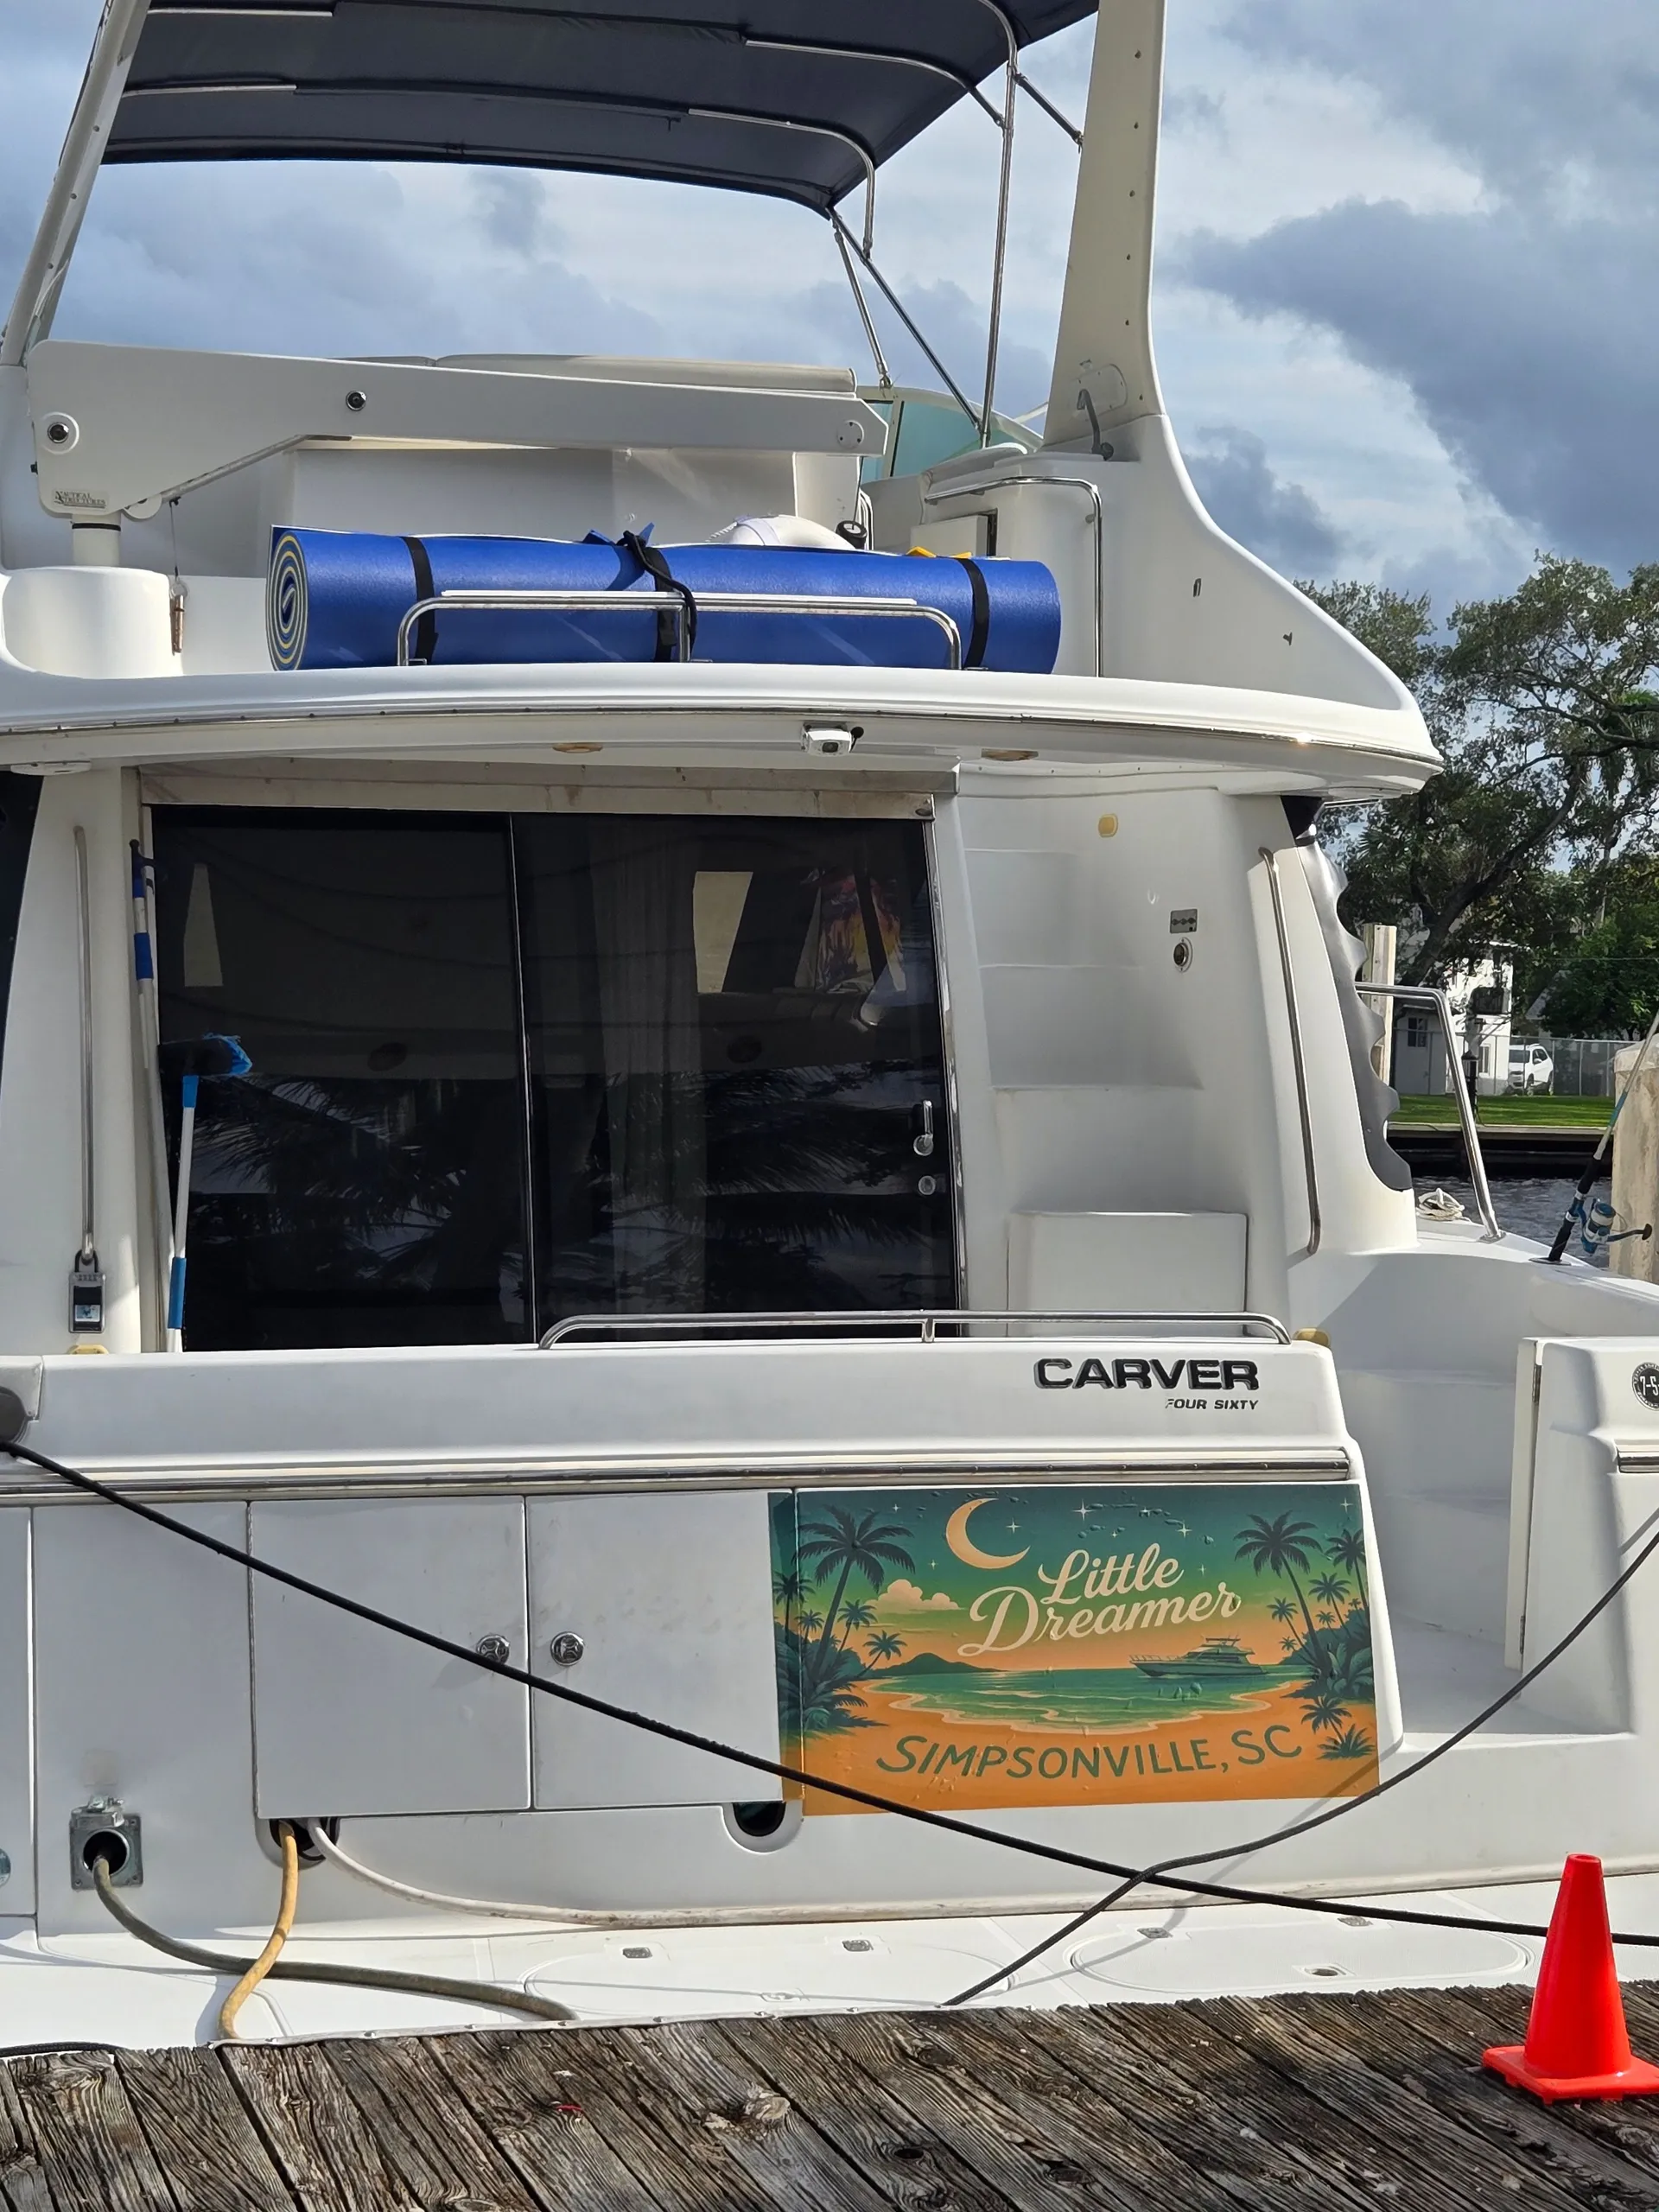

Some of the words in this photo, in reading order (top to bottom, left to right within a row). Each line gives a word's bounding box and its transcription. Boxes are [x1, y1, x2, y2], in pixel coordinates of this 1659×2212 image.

[1033, 1357, 1260, 1390] CARVER
[1165, 1398, 1208, 1410] FOUR
[1214, 1399, 1259, 1410] SIXTY
[1037, 1542, 1185, 1605] Little
[957, 1581, 1242, 1657] Dreamer
[875, 1734, 1229, 1780] SIMPSONVILLE,
[1230, 1725, 1303, 1766] SC
